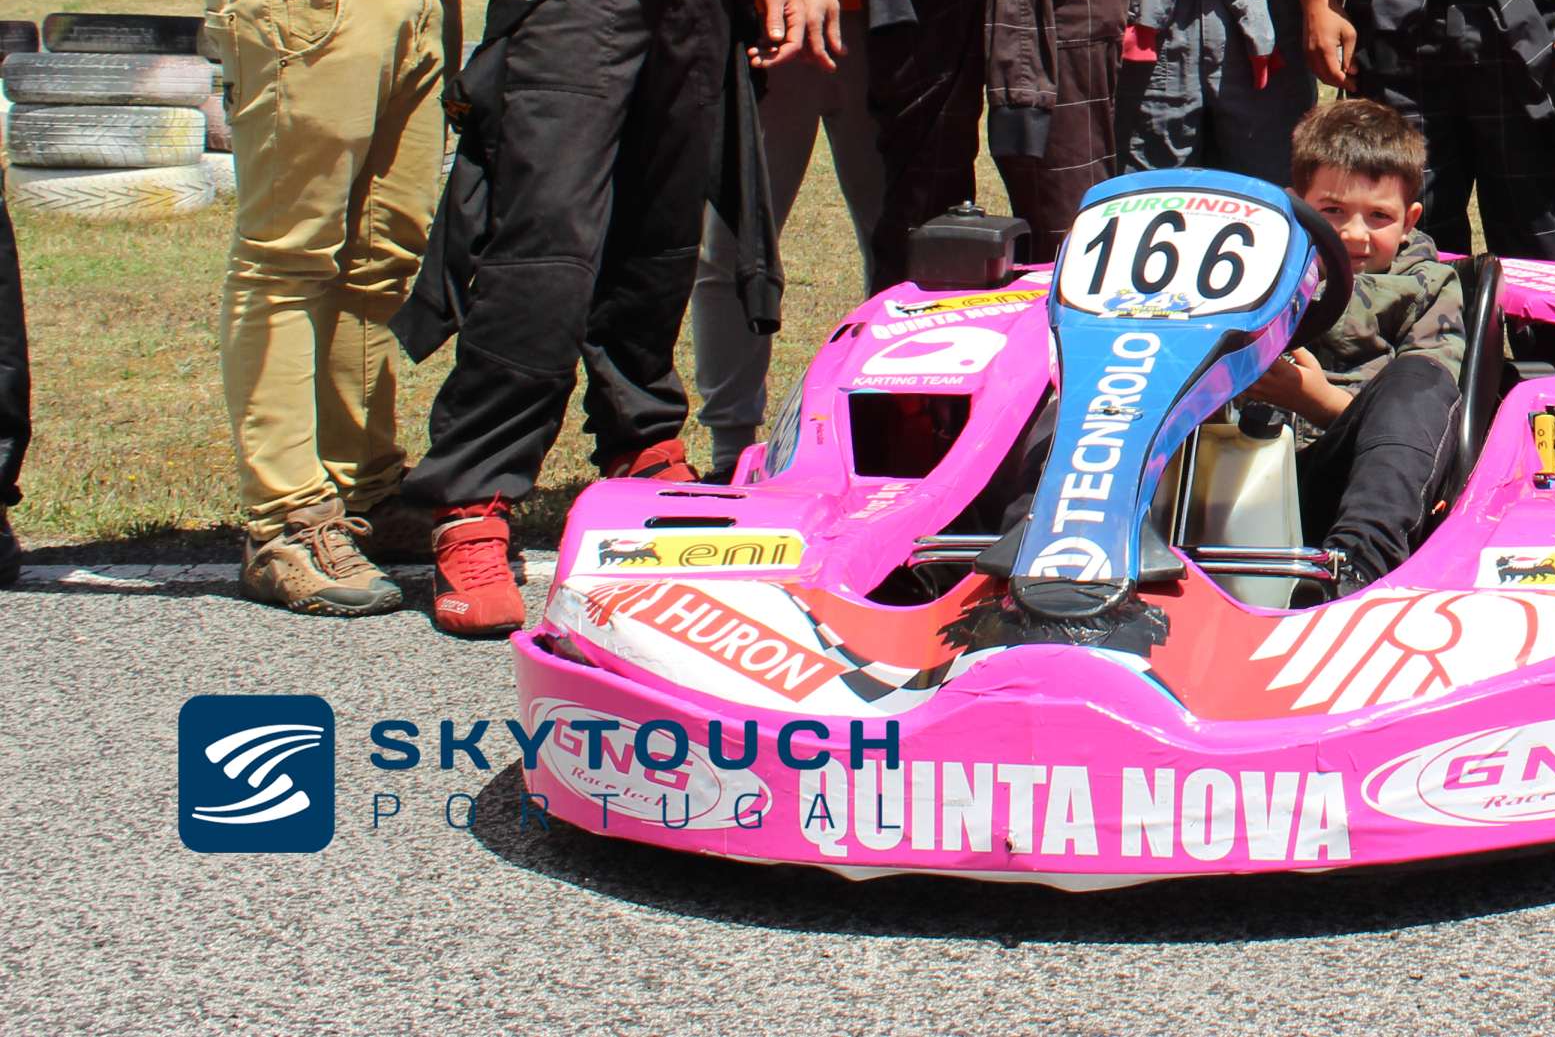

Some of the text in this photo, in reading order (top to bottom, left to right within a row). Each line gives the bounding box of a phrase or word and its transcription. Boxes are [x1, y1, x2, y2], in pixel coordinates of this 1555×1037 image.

[1101, 196, 1264, 219] EUROINDY
[1083, 209, 1256, 300] 166
[870, 302, 1034, 341] QUINTA NOVA
[852, 375, 964, 386] KARTING TEAM
[1052, 331, 1162, 534] TECNIROLO
[678, 536, 789, 567] eni
[655, 591, 825, 692] HURON
[553, 715, 694, 792] GNG
[571, 766, 617, 790] Race
[800, 758, 1352, 861] QUINTA NOVA
